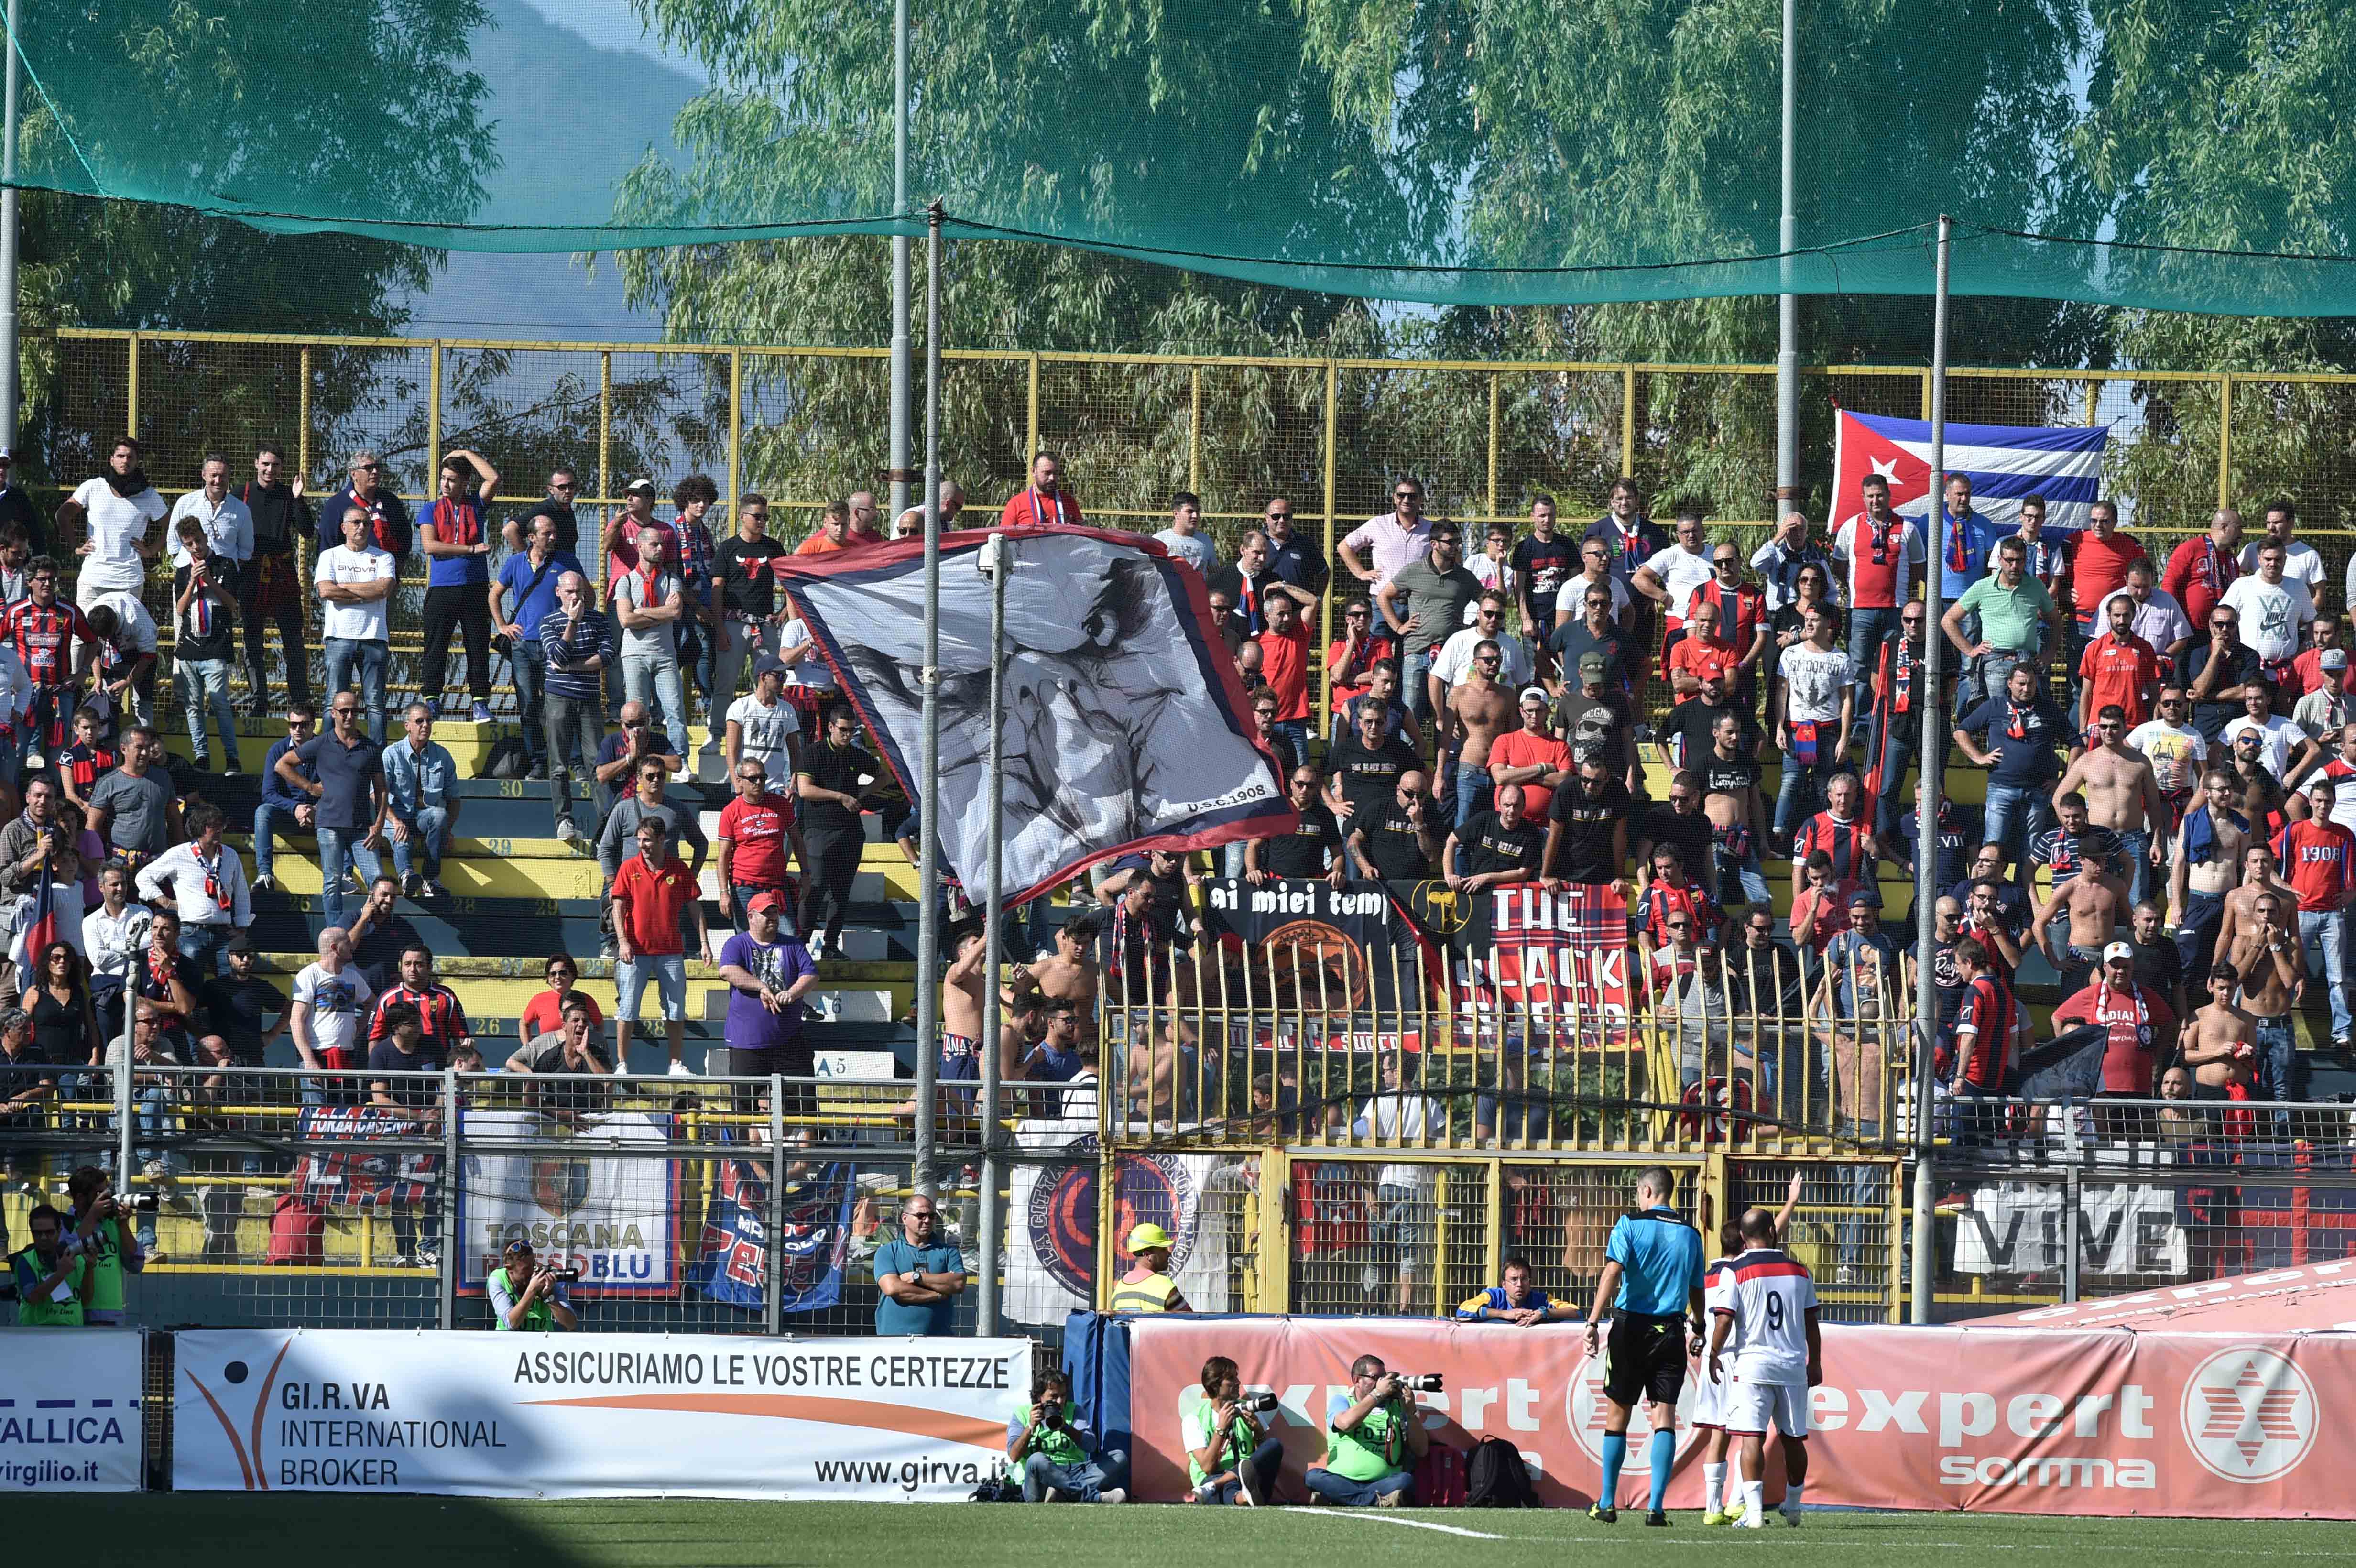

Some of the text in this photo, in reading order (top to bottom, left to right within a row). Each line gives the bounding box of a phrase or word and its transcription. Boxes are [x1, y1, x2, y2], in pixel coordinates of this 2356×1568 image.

[338, 565, 376, 573] GIVOVA
[2265, 612, 2286, 622] NIKE
[500, 780, 523, 797] 30
[2301, 846, 2340, 862] 1908
[1210, 879, 1238, 911] ai
[1251, 882, 1315, 915] miei
[1492, 888, 1584, 933] THE
[475, 1018, 500, 1035] 26
[485, 1223, 645, 1249] TOSCANA
[1973, 1210, 2174, 1272] VIVE
[1766, 1290, 1784, 1331] 9
[514, 1351, 1009, 1389] ASSICURIAMO LE VOSTRE CERTEZZE
[281, 1382, 391, 1410] GI.R.VA
[1806, 1384, 2154, 1447] expert
[0, 1417, 125, 1444] ALLICA
[281, 1420, 507, 1448] INTERNATIONAL
[281, 1459, 398, 1486] BROKER
[814, 1455, 1009, 1492] www.girva.it
[1940, 1455, 2156, 1489] somma
